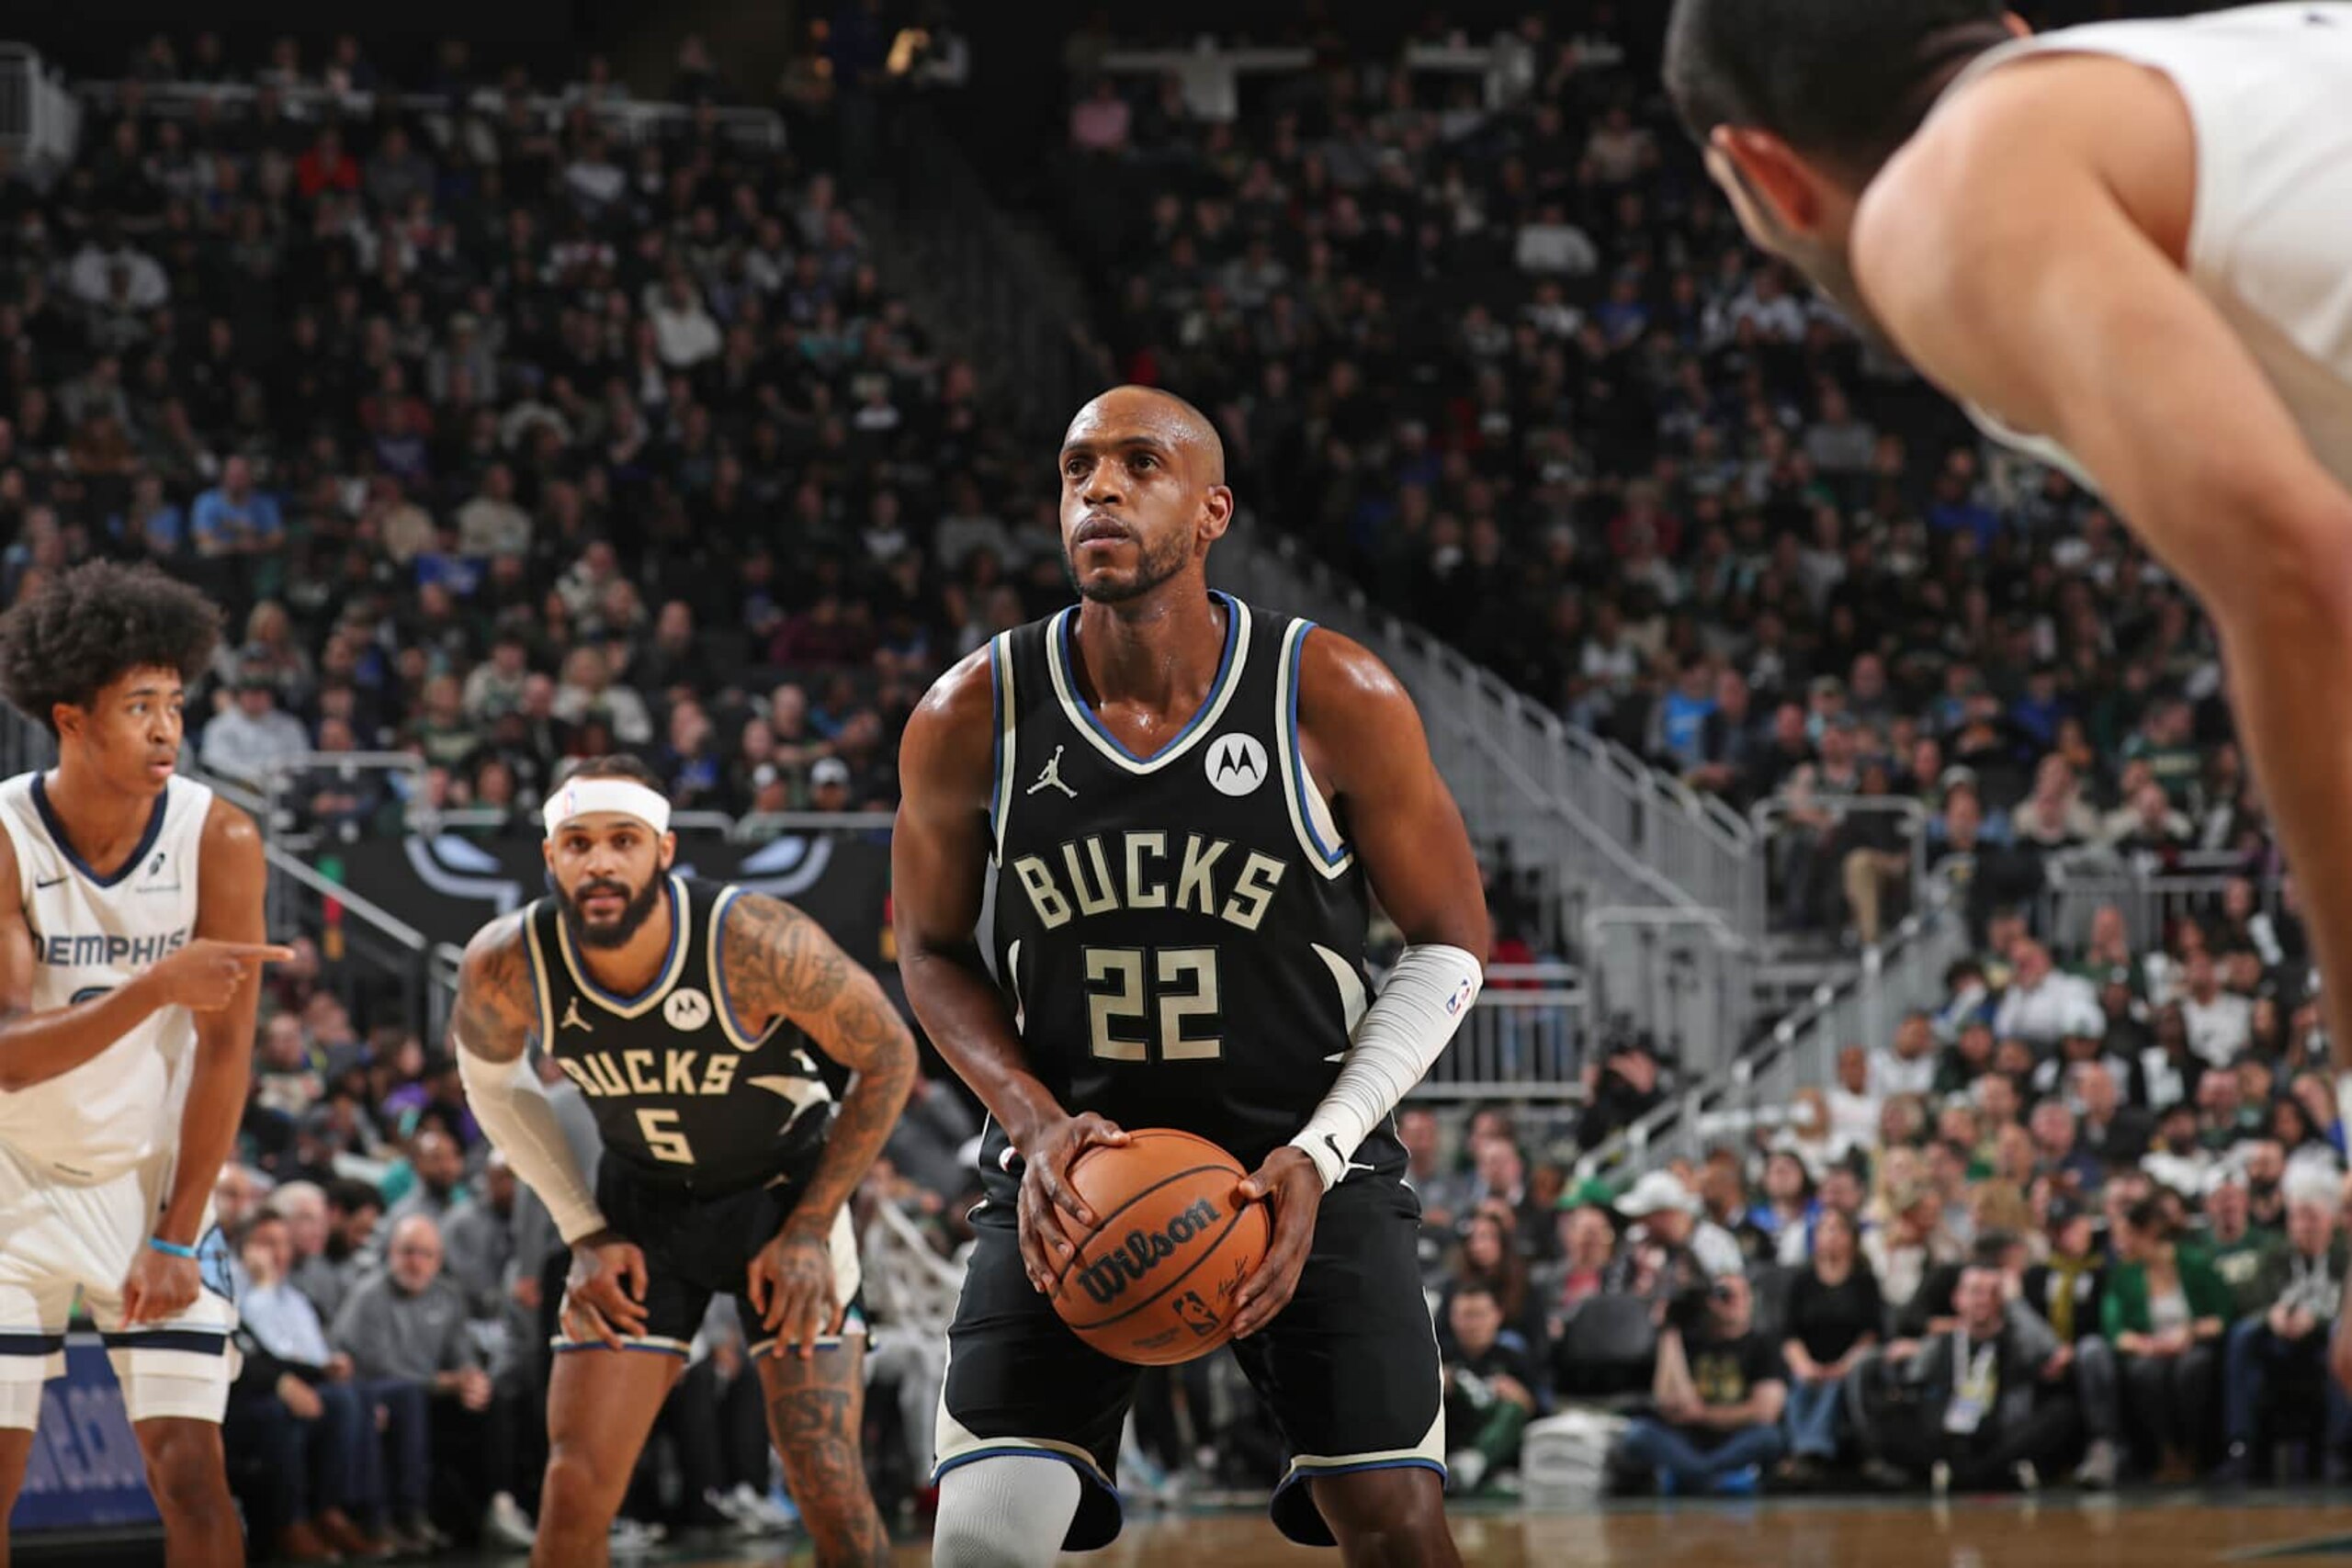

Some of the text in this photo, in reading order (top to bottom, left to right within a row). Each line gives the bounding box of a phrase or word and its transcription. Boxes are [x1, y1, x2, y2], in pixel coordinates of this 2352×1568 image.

[1012, 830, 1286, 931] BUCKS
[1082, 945, 1223, 1062] 22
[636, 1108, 695, 1165] 5
[1076, 1198, 1221, 1304] Wilson
